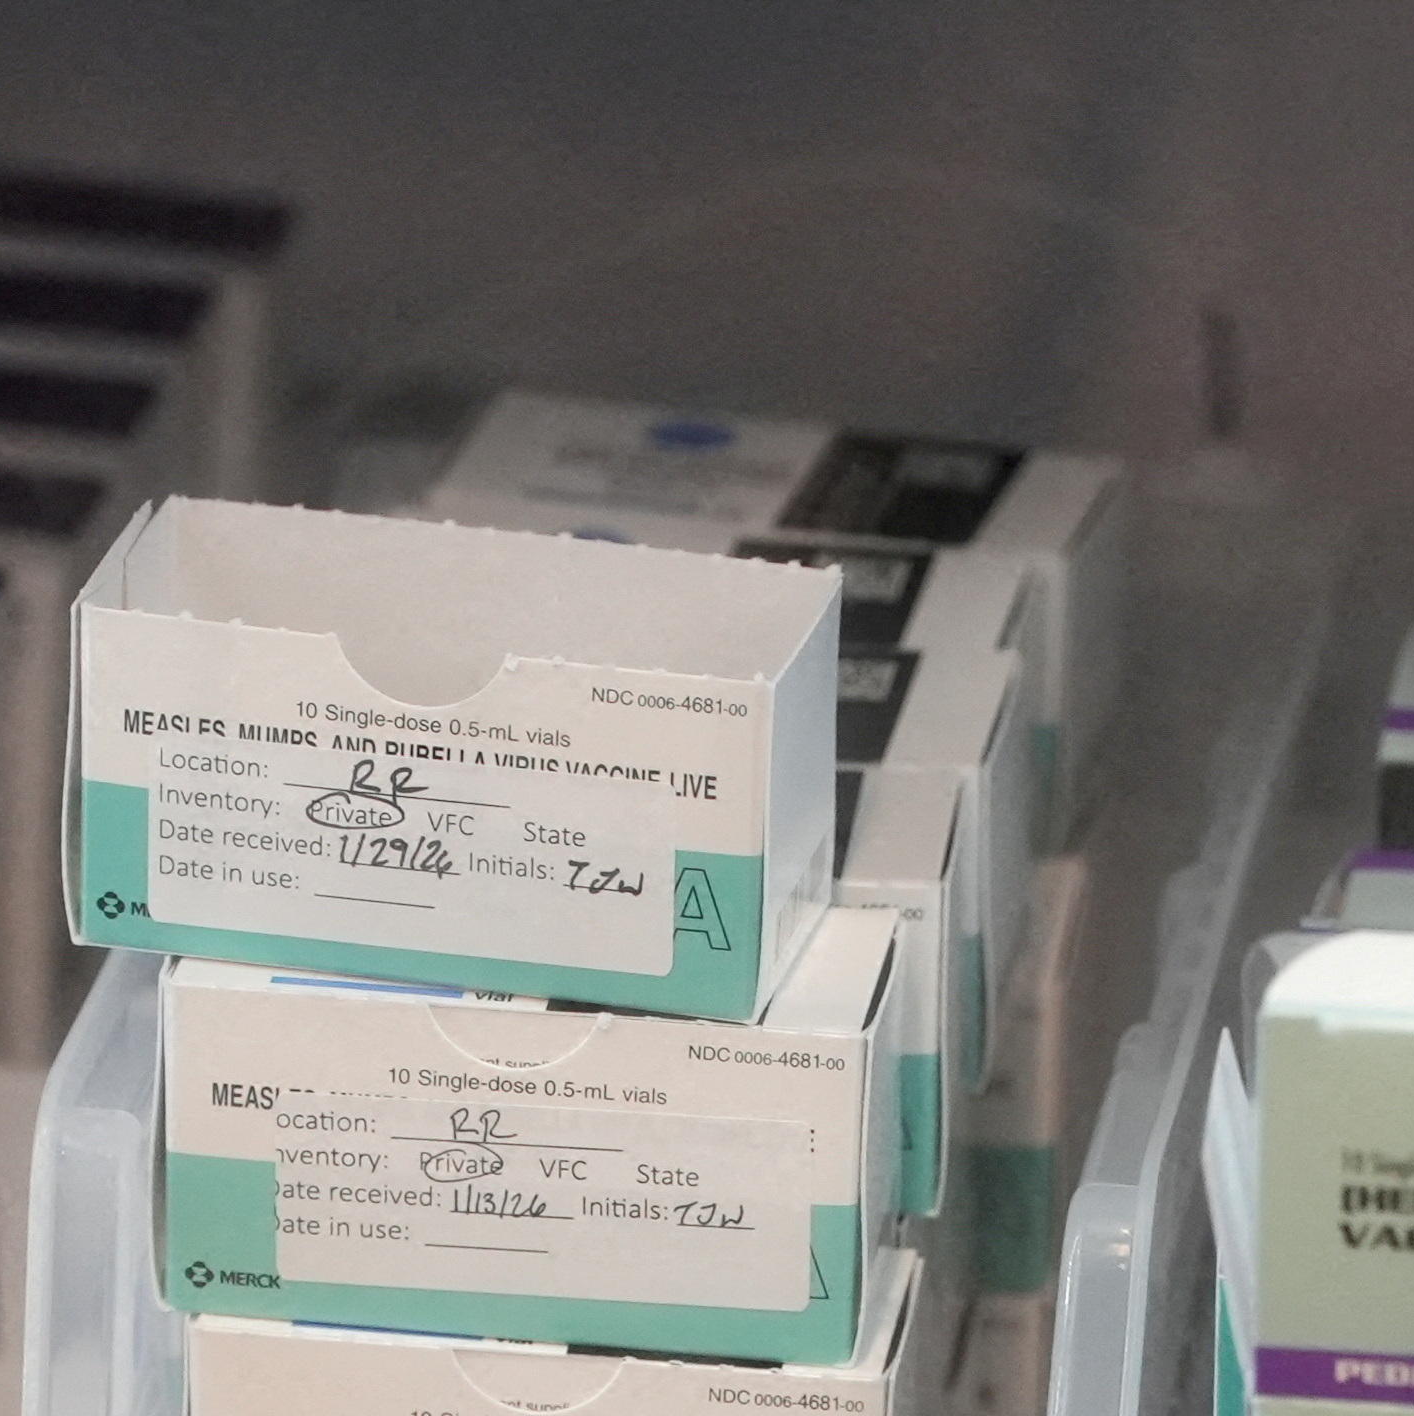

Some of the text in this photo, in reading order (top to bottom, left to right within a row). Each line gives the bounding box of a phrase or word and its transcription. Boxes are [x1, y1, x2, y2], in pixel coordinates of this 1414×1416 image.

[591, 687, 748, 718] NDC 0006-4681-00
[297, 701, 571, 748] 10 Single-dose 0.5-mL vials
[160, 747, 269, 778] Location:
[159, 783, 587, 848] Inventory: Private VFC State
[160, 819, 214, 845] Date
[222, 830, 332, 858] received:
[469, 852, 555, 881] Initials:
[160, 855, 300, 891] Date in use:
[688, 1044, 846, 1072] NDC 0006-4681-00
[388, 1067, 668, 1106] 10 Single-dose 0.5-mL vials
[276, 1111, 377, 1134] ocation:
[276, 1147, 700, 1188] nventory: Private VFC State
[275, 1179, 322, 1201] ate
[330, 1184, 443, 1208] received:
[582, 1196, 669, 1221] Initials:
[275, 1216, 411, 1242] ate in use:
[220, 1270, 281, 1290] MERCK
[709, 1386, 866, 1414] NDC 0006-4681-00
